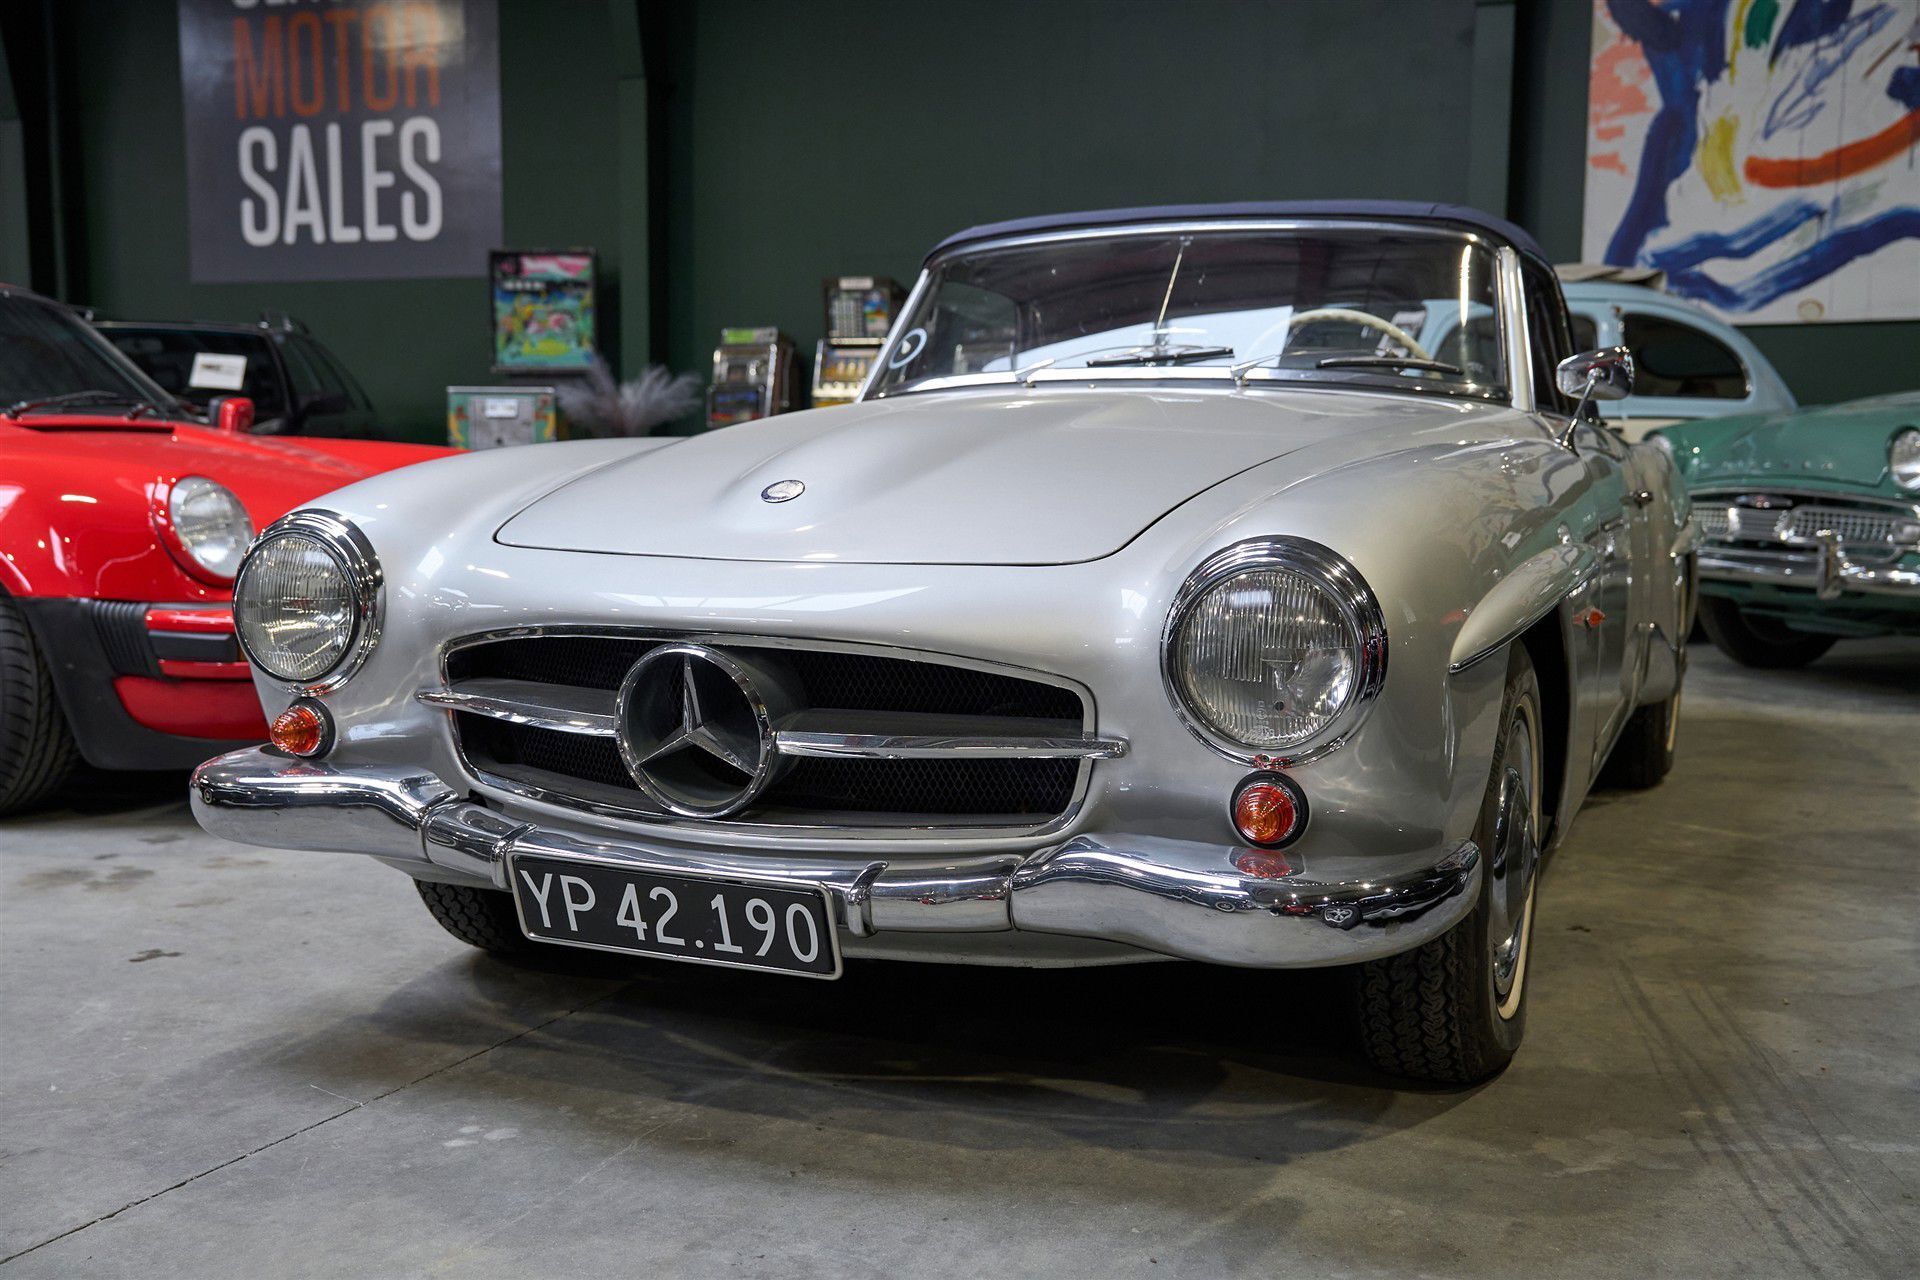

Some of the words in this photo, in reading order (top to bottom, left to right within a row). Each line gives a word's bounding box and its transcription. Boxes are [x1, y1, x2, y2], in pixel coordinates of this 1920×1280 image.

[234, 4, 442, 119] MOTOR
[238, 116, 443, 247] SALES
[520, 869, 596, 931] YP
[616, 883, 819, 963] 42.190
